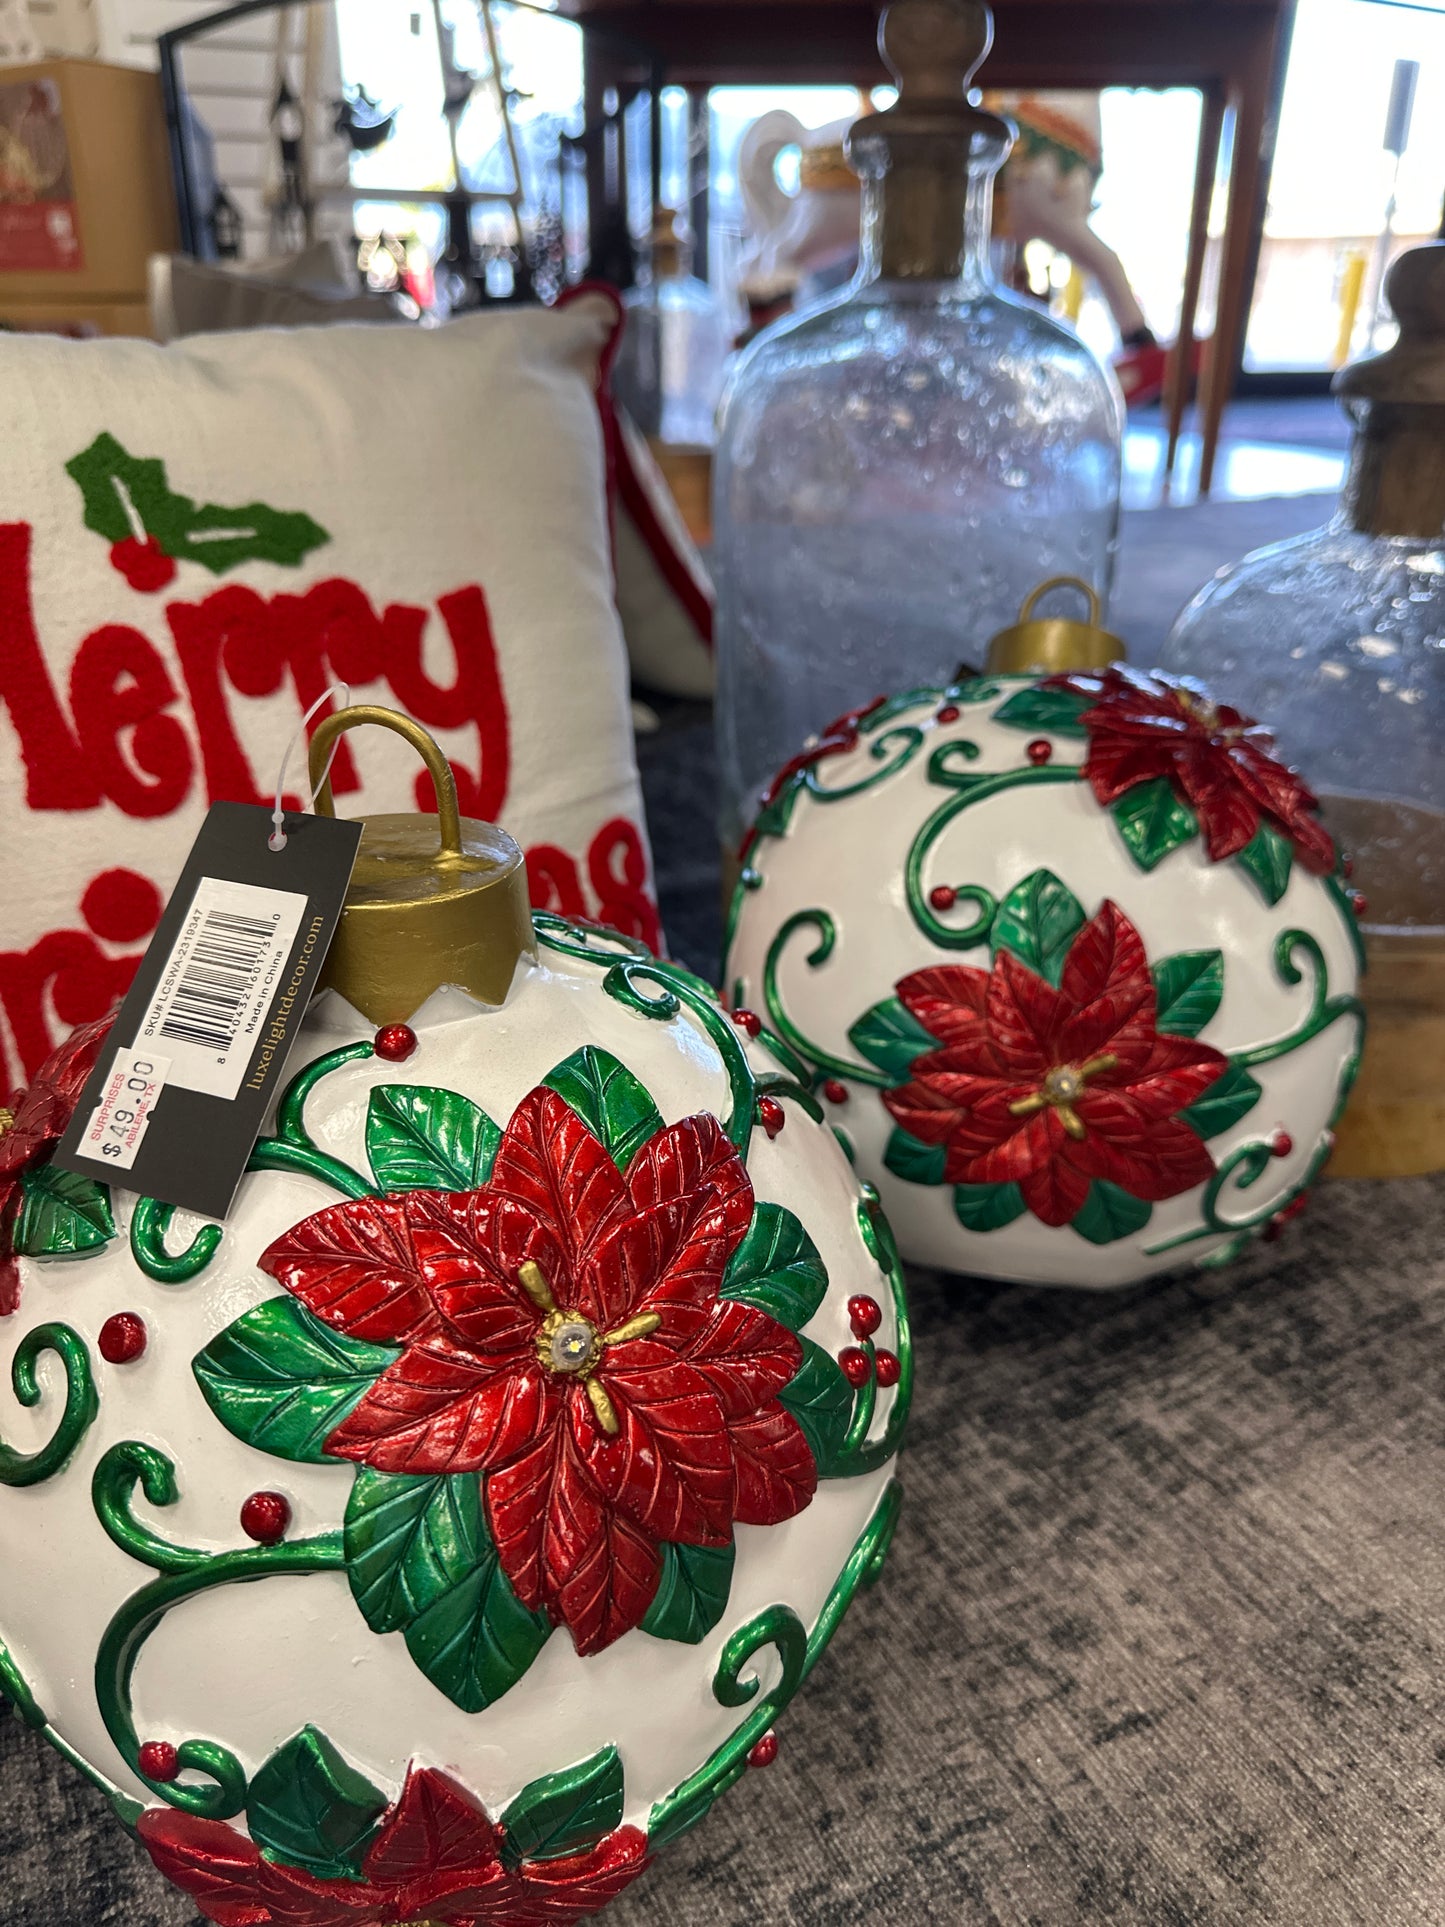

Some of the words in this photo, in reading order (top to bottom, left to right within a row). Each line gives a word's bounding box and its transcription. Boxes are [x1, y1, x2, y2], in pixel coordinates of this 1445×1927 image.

[144, 1004, 164, 1036] SKU#
[159, 909, 203, 1003] LCSWA-2319347
[261, 988, 270, 1000] in
[264, 950, 284, 984] China
[217, 1057, 226, 1065] 8
[228, 993, 251, 1035] 40432
[250, 941, 271, 982] 60173
[245, 1001, 264, 1034] Made
[246, 916, 324, 1090] luxelightdecor.com
[91, 1073, 125, 1141] SURPRISES
[125, 1101, 151, 1148] ABILENE,
[144, 1083, 157, 1098] TX
